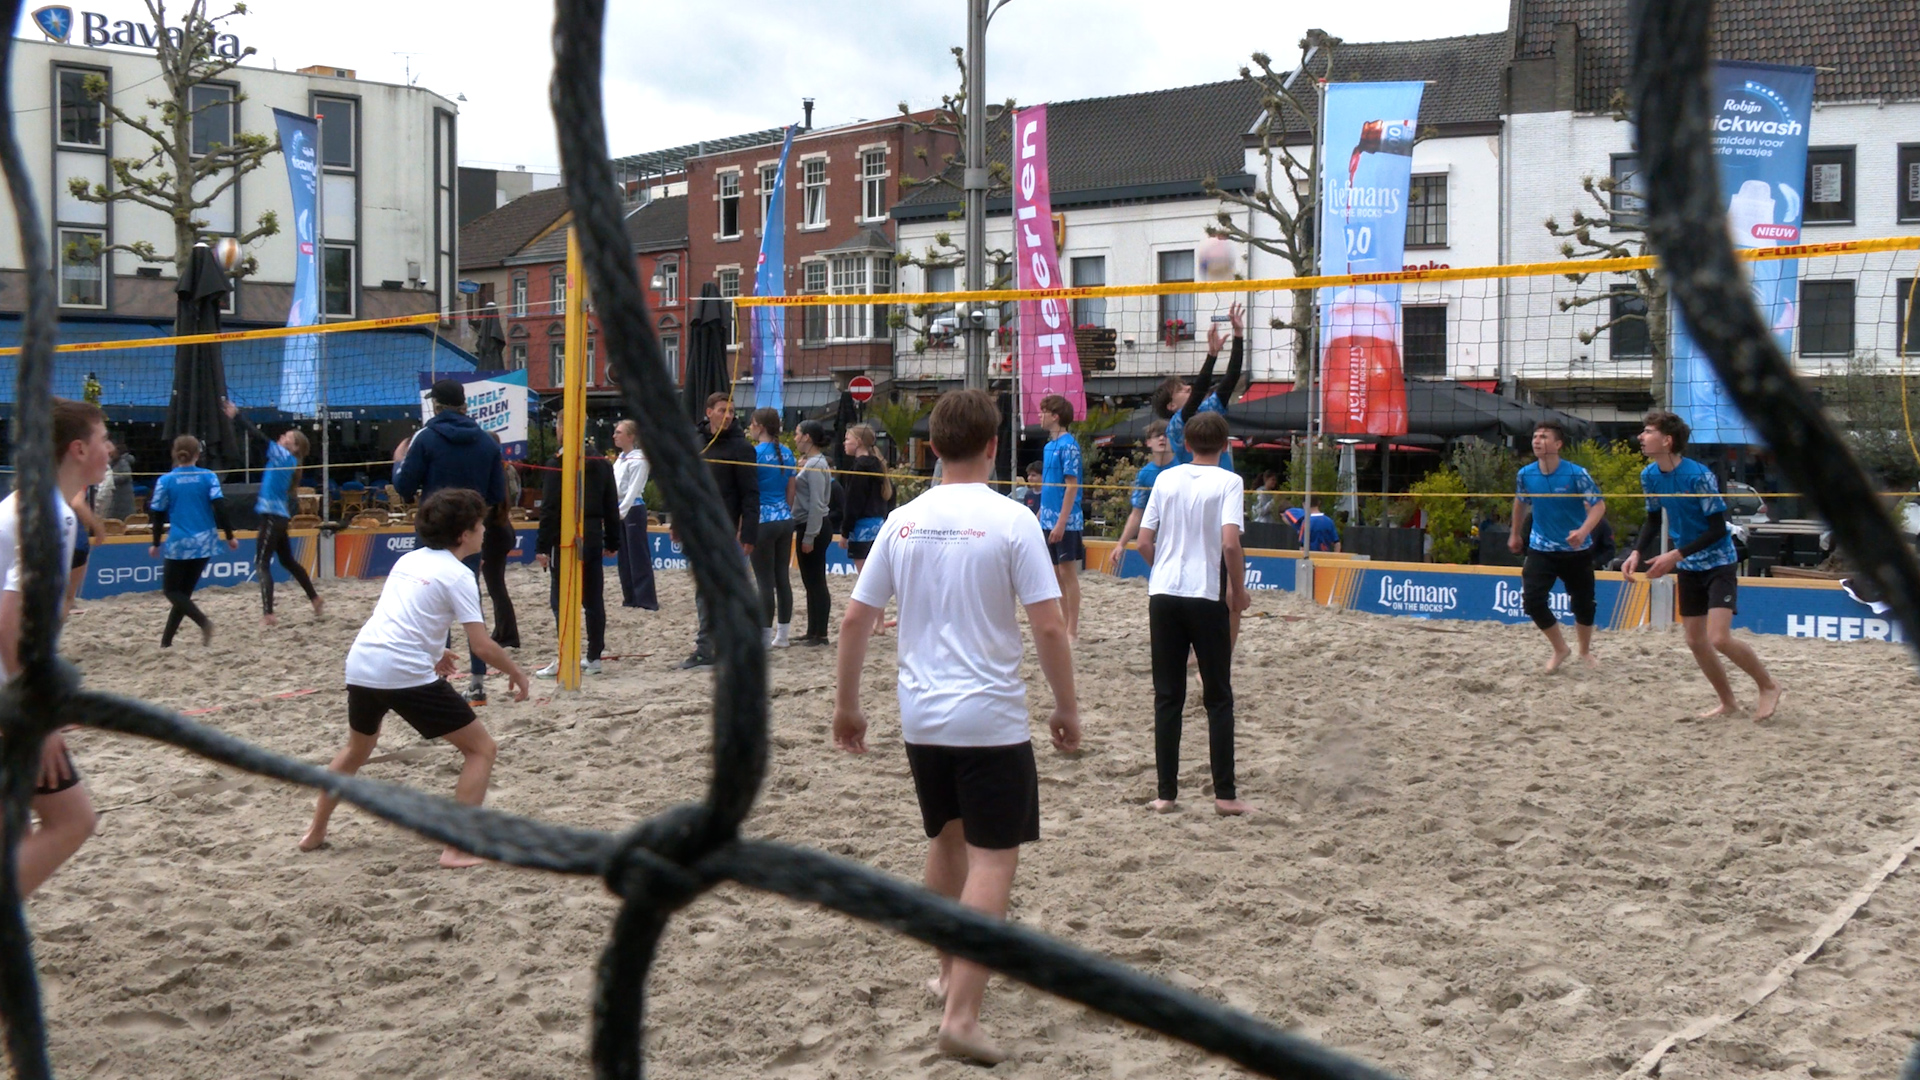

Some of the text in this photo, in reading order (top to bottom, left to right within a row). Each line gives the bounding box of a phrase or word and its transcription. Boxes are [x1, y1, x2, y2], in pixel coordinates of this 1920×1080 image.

[81, 11, 240, 59] Bavaia
[1723, 99, 1762, 114] Robijn
[1712, 115, 1802, 136] ickwash
[1759, 139, 1784, 148] voor
[1736, 148, 1773, 157] wasjes
[1329, 179, 1400, 215] Liefmans
[1357, 208, 1383, 218] ROCKS
[1756, 226, 1795, 238] NIEUW
[1017, 120, 1073, 378] Heerlen
[1758, 241, 1858, 257] FUNTEC
[1351, 271, 1430, 283] FUNTEC
[1030, 288, 1092, 298] FUNTEC
[466, 399, 509, 420] ERLEN
[1378, 575, 1458, 609] Liefmans
[1492, 580, 1575, 616] Liefan
[1392, 602, 1444, 612] ON THE ROCKS
[1507, 608, 1519, 616] ON
